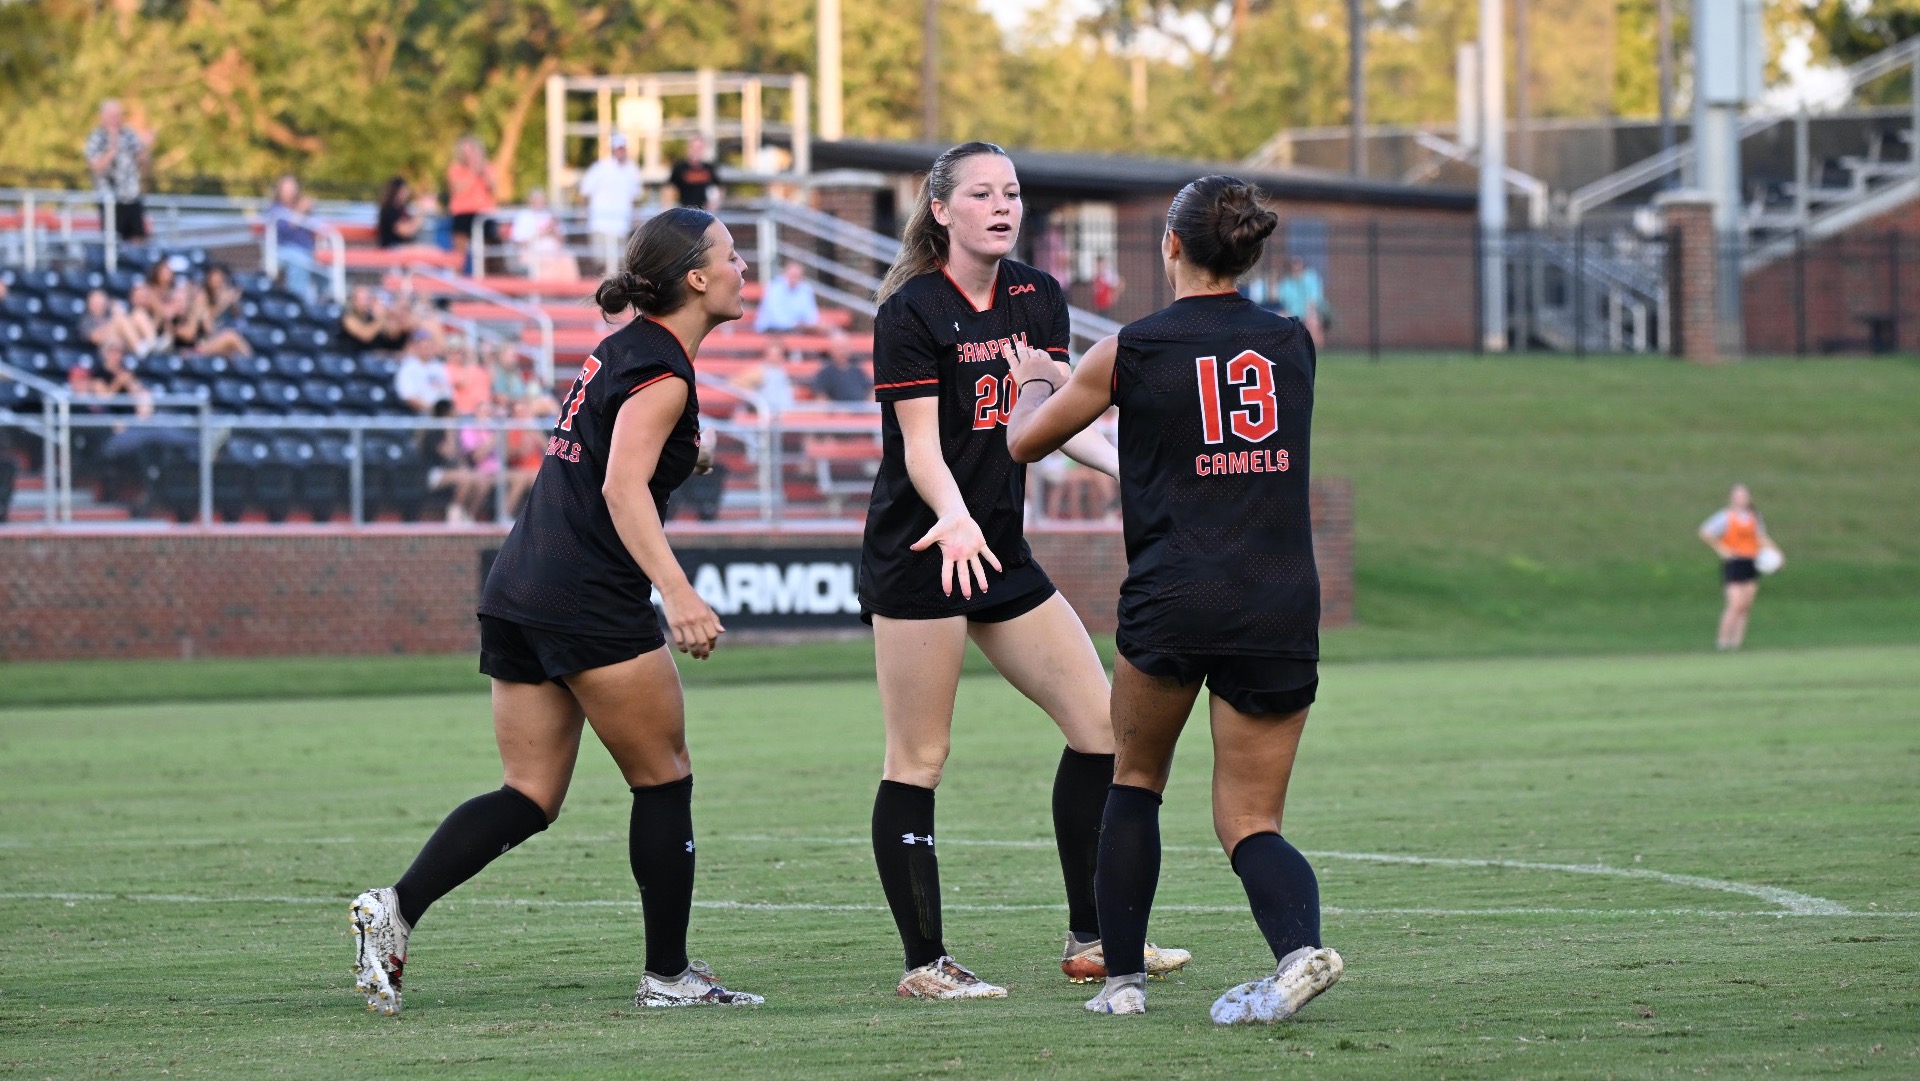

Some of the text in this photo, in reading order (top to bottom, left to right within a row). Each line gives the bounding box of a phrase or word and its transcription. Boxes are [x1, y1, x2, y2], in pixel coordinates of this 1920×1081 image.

[1008, 283, 1036, 297] CAA
[957, 331, 1034, 363] CAMPL
[972, 368, 1019, 430] 20
[1195, 349, 1278, 444] 13
[1195, 449, 1289, 476] CAMELS
[692, 562, 862, 615] ARMOU
